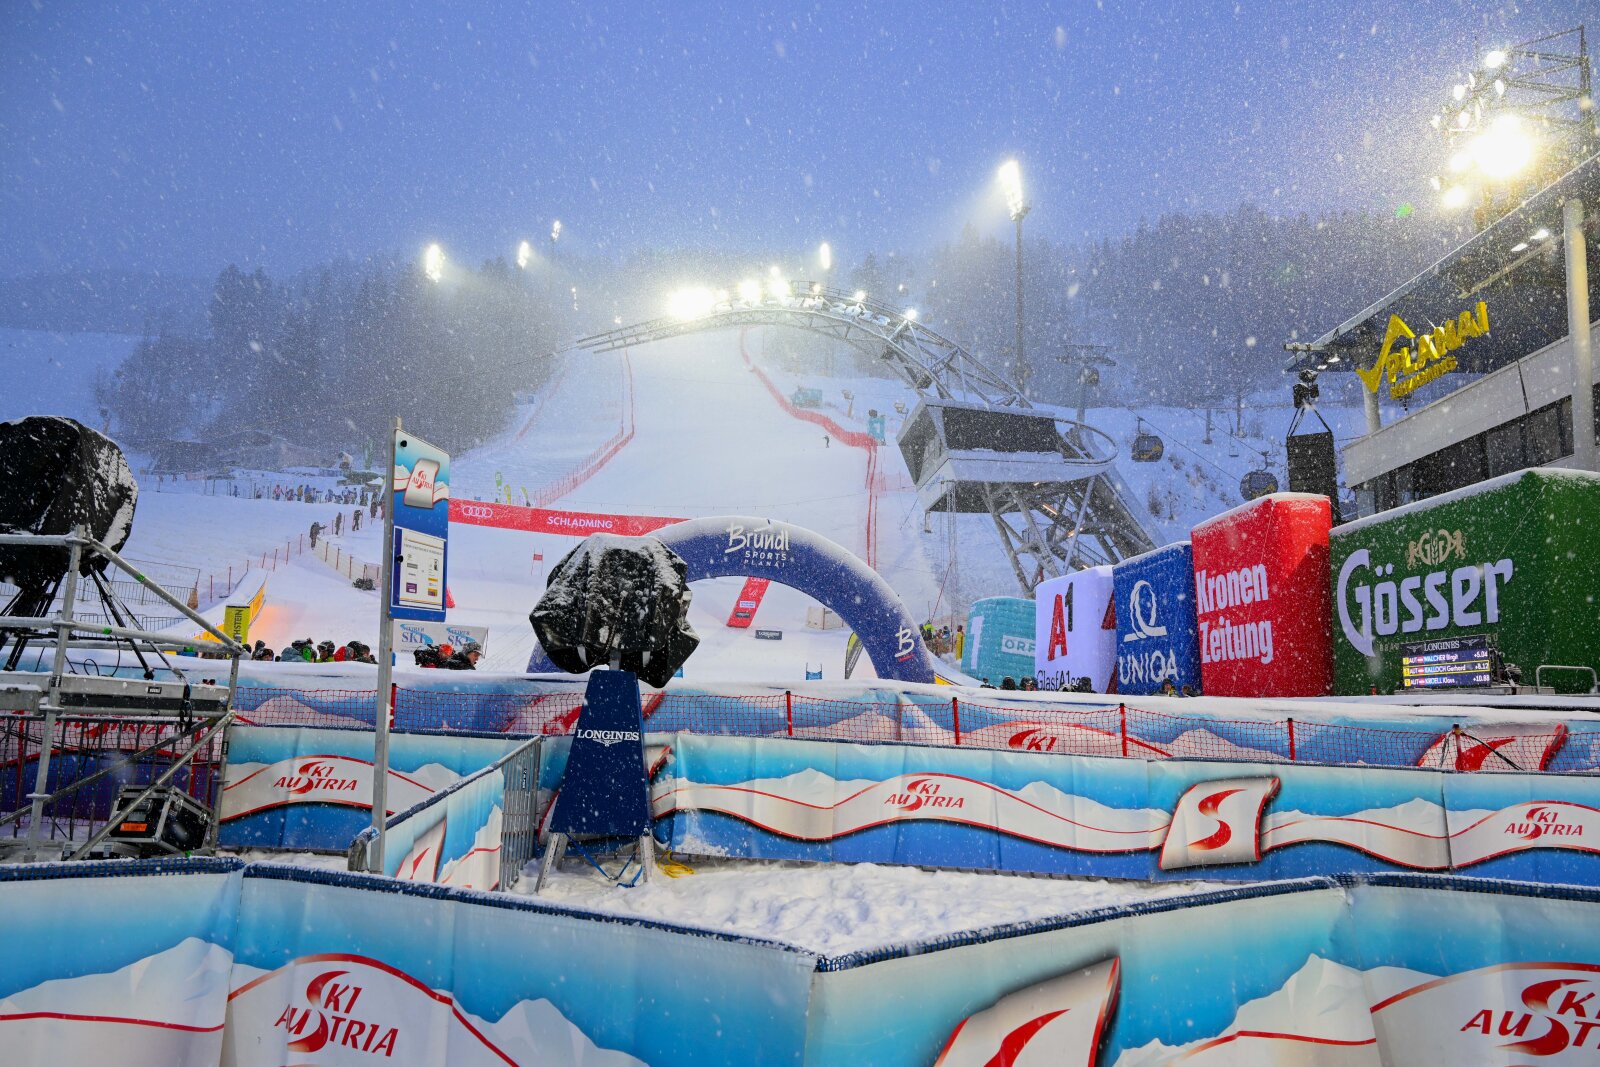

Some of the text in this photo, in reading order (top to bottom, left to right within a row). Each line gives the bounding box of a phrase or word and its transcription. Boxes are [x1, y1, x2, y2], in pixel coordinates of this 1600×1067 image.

[1385, 300, 1490, 384] PLANAI
[547, 516, 613, 529] SCHLADMING
[744, 559, 785, 568] PLANAI
[745, 551, 787, 561] SPORTS
[1196, 562, 1269, 613] Kronen
[1337, 548, 1513, 657] Gösser
[401, 632, 423, 643] SKI
[1004, 639, 1036, 652] ORF
[1200, 620, 1274, 665] Zeitung
[1423, 640, 1460, 652] LONGINES
[1119, 649, 1179, 685] UNIQA
[577, 729, 640, 741] LONGINES
[273, 776, 358, 795] AUSTRIA
[884, 792, 965, 811] AUSTRIA
[1504, 823, 1583, 840] AUSTRIA
[274, 1003, 399, 1057] AUSTRIA
